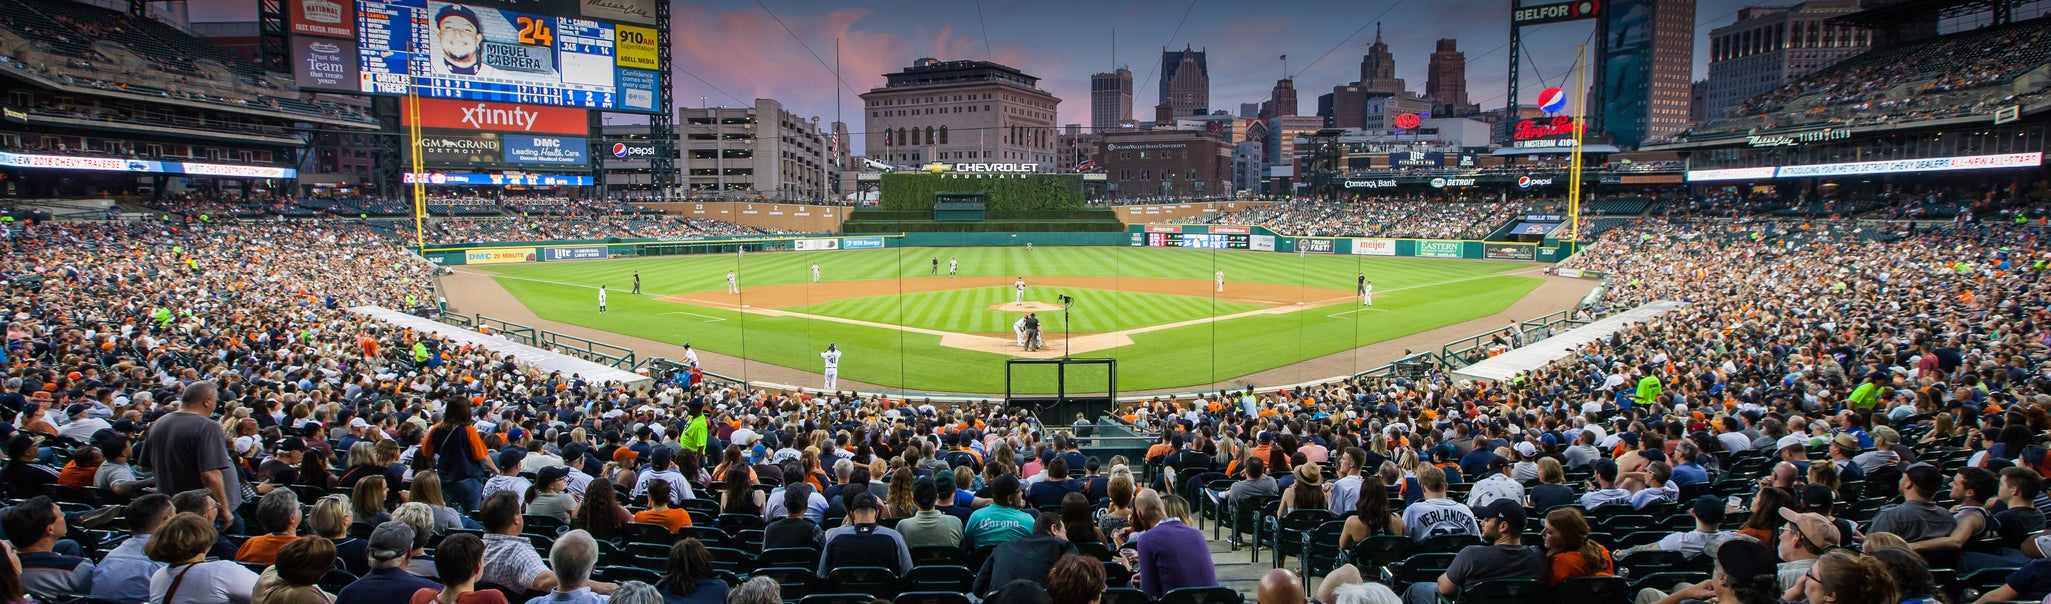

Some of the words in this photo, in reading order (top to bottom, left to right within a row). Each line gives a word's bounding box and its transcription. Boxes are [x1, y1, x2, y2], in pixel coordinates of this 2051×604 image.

[307, 6, 338, 16] NATIONAL
[1515, 5, 1569, 21] BELFOR
[517, 16, 553, 46] 24
[486, 44, 529, 57] MIGUEL
[307, 58, 343, 72] Team
[486, 54, 540, 69] CABRERA
[622, 70, 653, 78] Confidence
[376, 82, 407, 94] TIGERS
[461, 103, 538, 130] xfinity
[1800, 132, 1824, 142] TIGER
[1831, 129, 1851, 139] CLUB
[457, 140, 496, 150] GRAND
[534, 138, 560, 147] DMC
[628, 146, 654, 156] pepsi
[1410, 151, 1425, 161] Lite
[34, 157, 52, 165] 2018
[55, 158, 80, 167] CHEVY
[84, 160, 120, 168] TRAVERSE
[956, 163, 1039, 172] CHEVROLET
[1890, 162, 1914, 170] CHEVY
[1421, 241, 1457, 250] EASTERN
[554, 249, 571, 259] Lite
[980, 518, 1019, 530] Corona
[1418, 509, 1473, 528] VERLANDER
